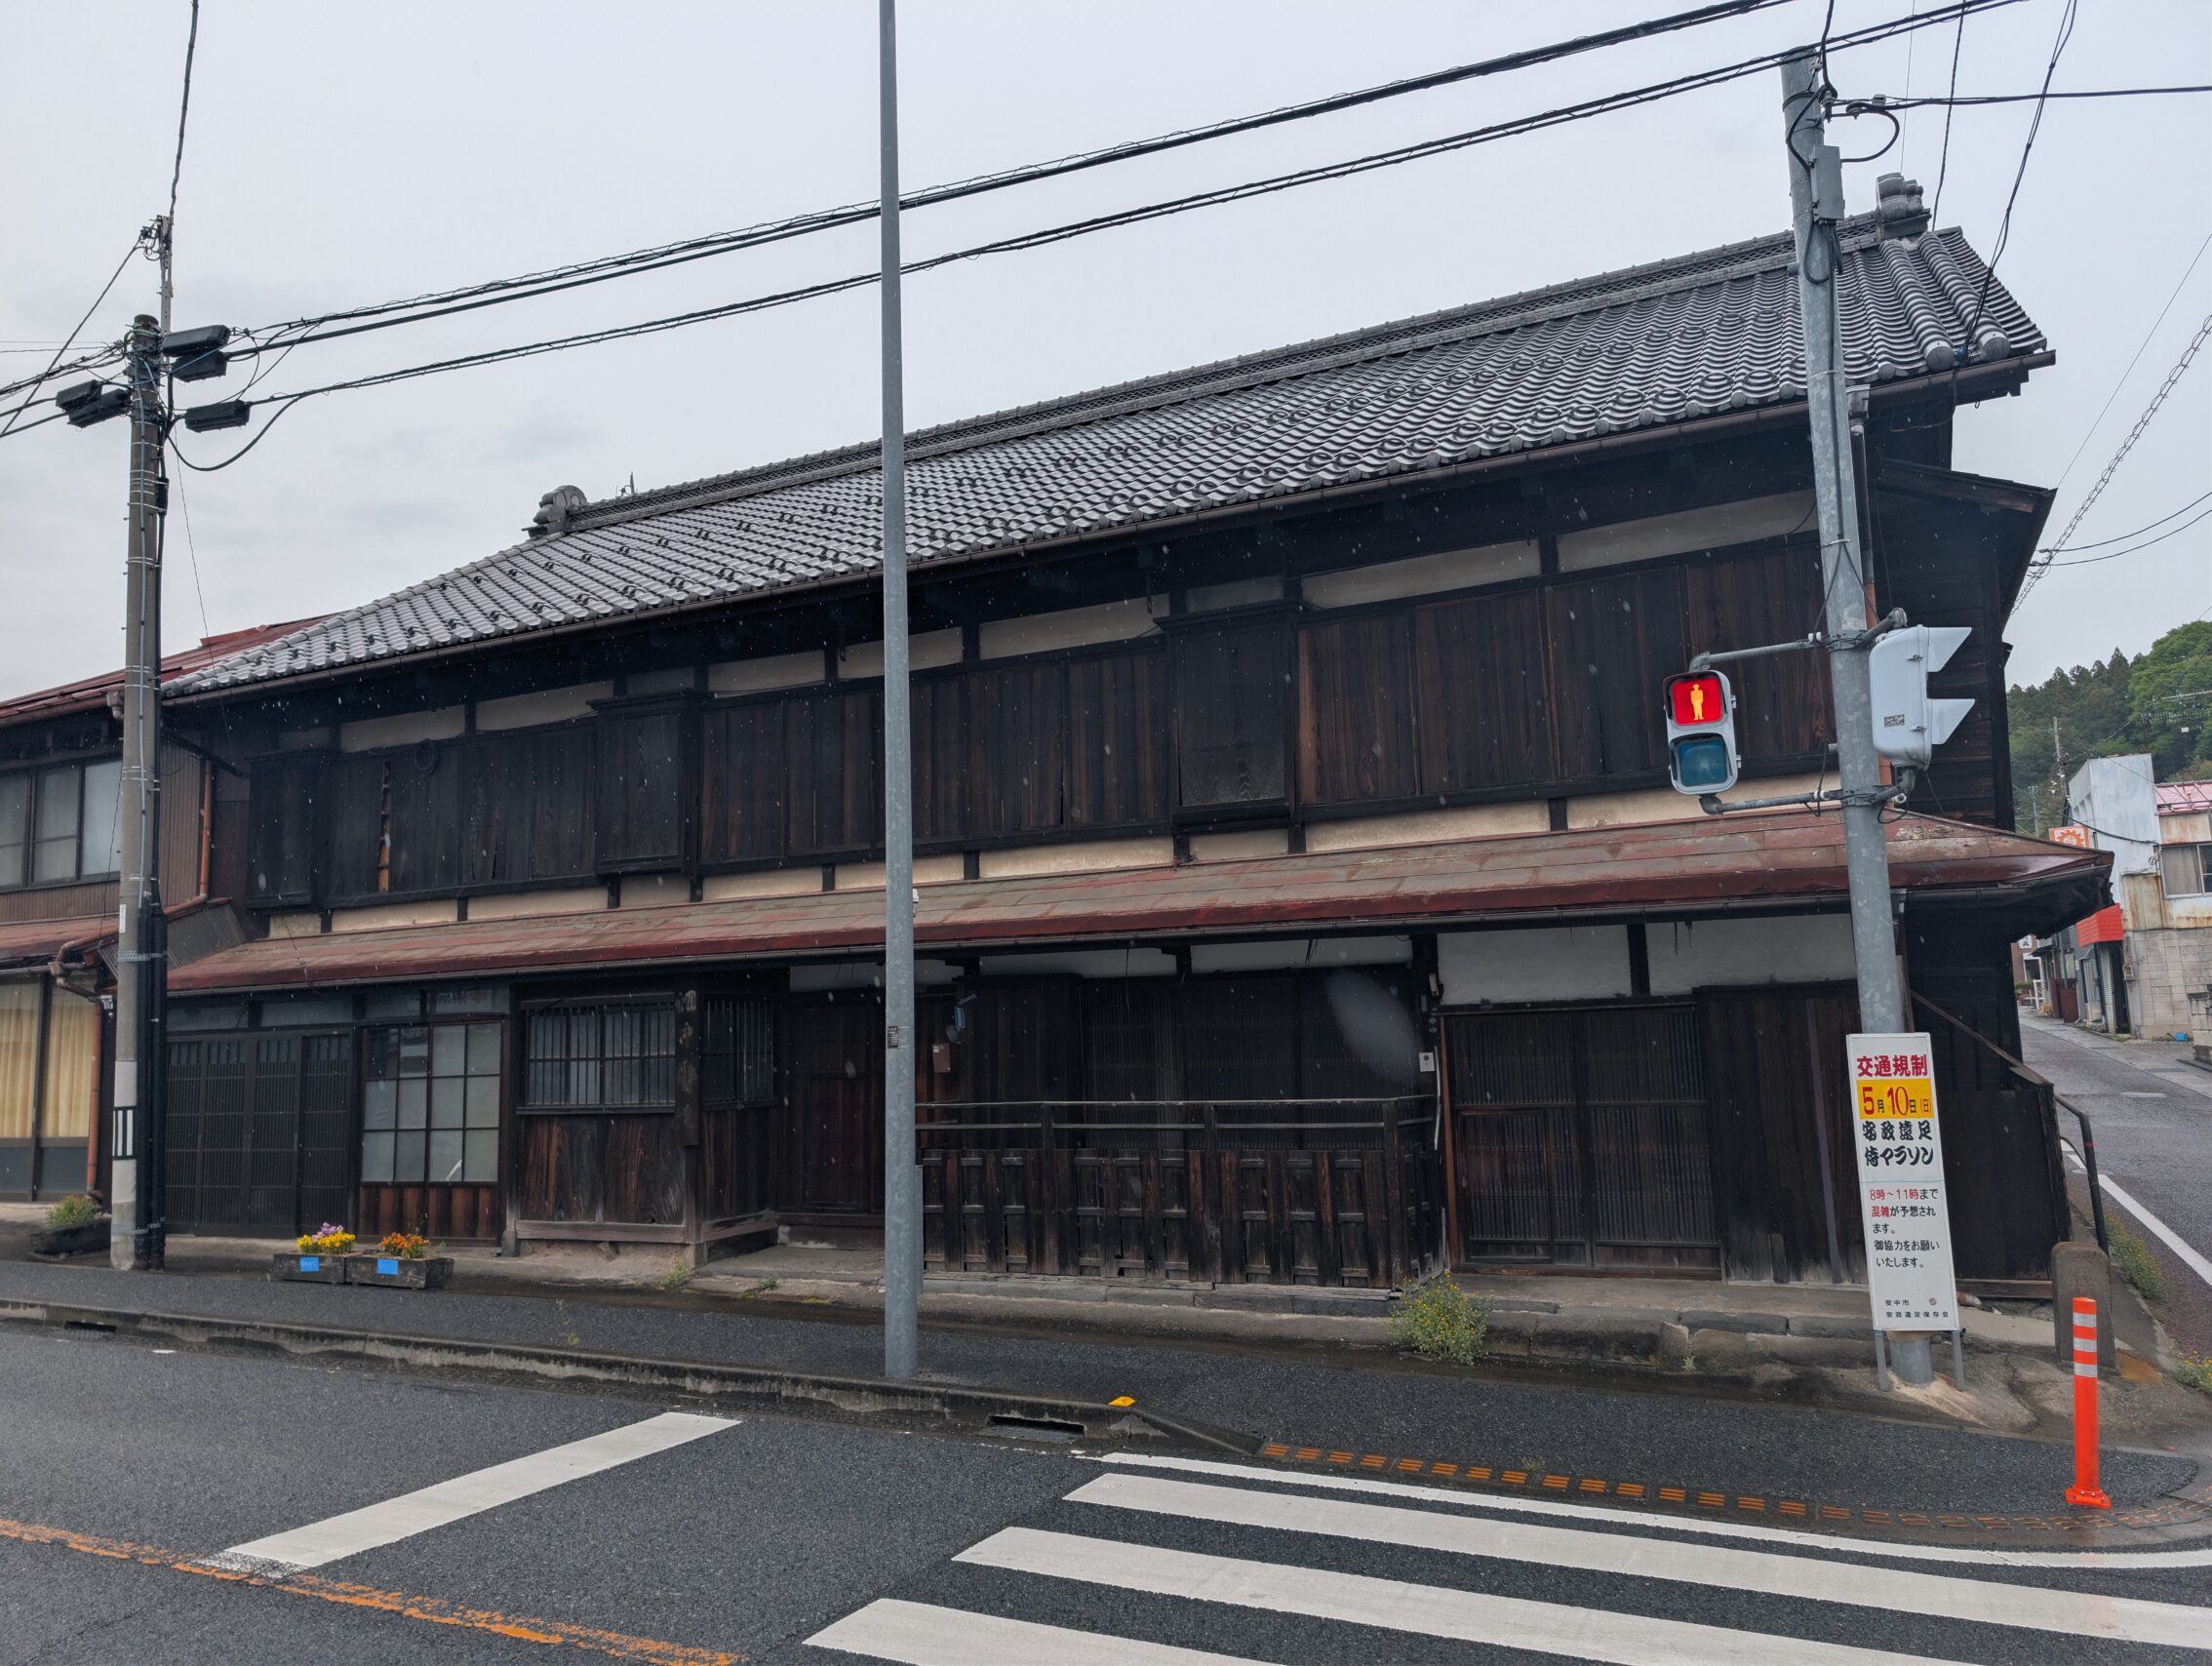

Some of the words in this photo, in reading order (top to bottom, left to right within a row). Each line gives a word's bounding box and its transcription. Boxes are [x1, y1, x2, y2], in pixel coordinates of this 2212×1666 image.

[1856, 1054, 1928, 1077] 交通規制
[1862, 1086, 1932, 1116] 5月10日(日)
[1862, 1120, 1932, 1141] 安政遠足
[1865, 1145, 1934, 1167] 侍マラソン
[1872, 1206, 1936, 1217] 混雑が予想され
[1873, 1223, 1895, 1234] ます。
[1874, 1240, 1940, 1251] 御協力をお願い
[1876, 1256, 1923, 1268] いたします。
